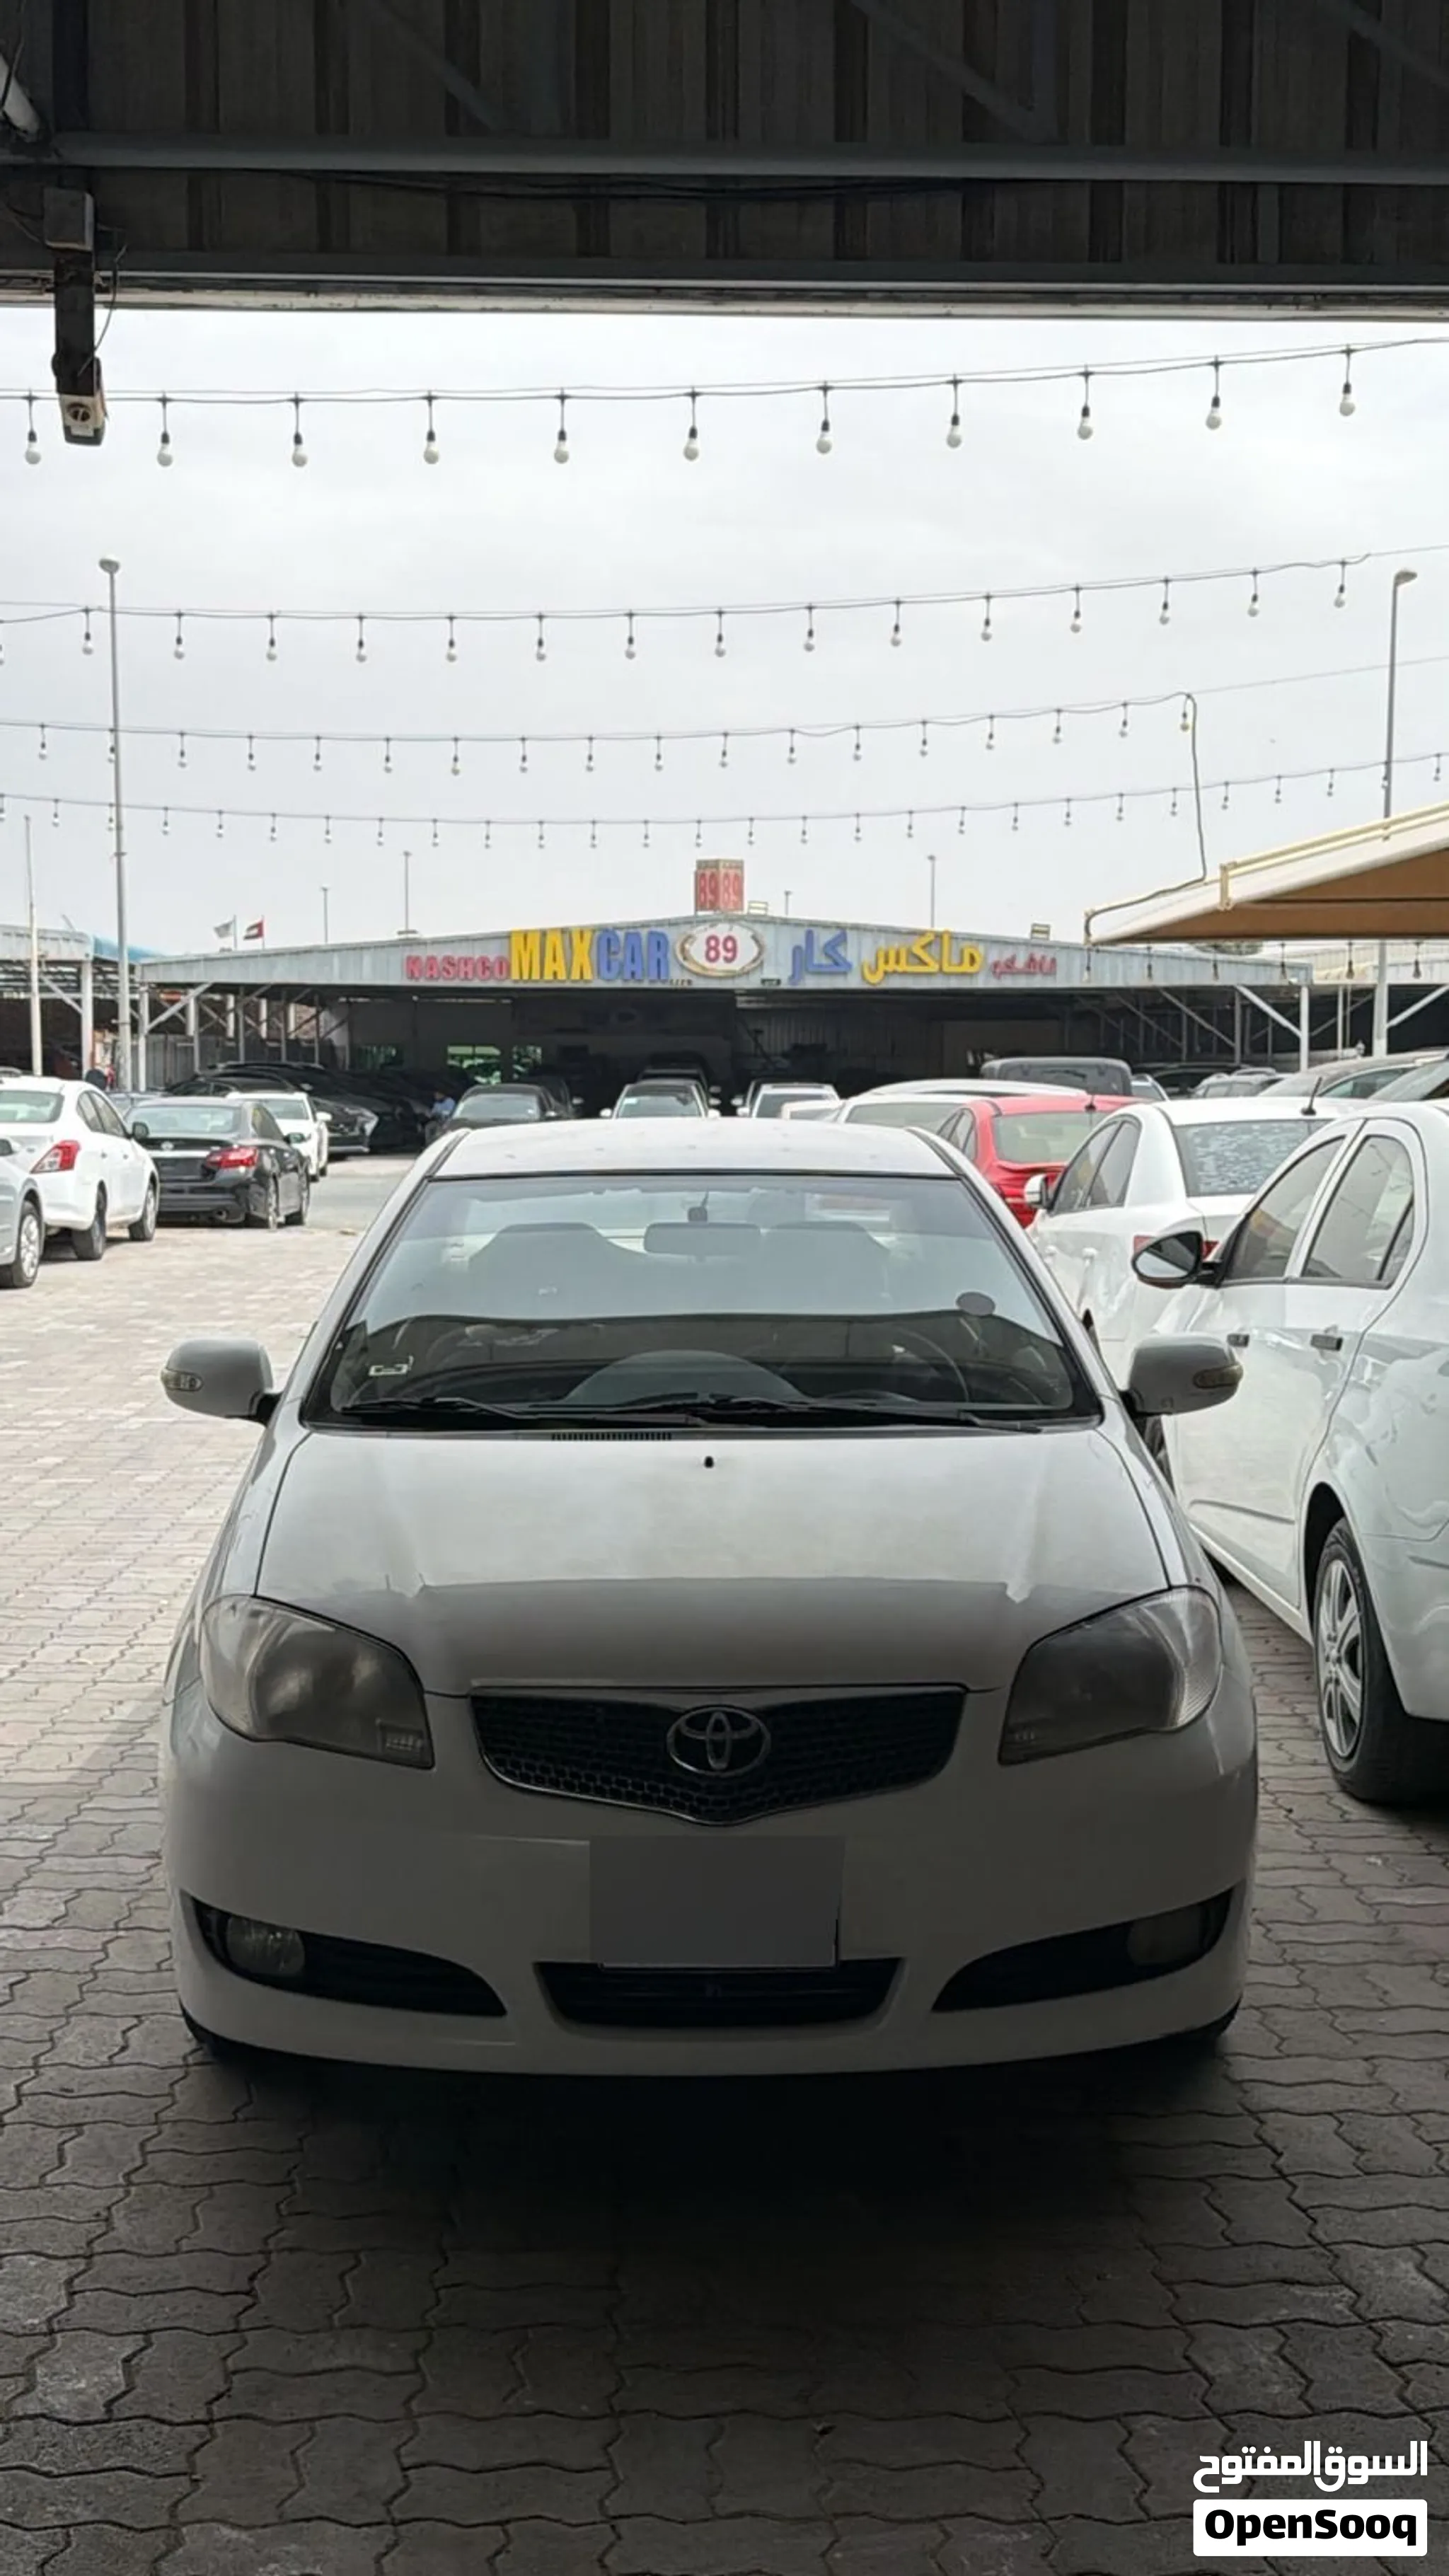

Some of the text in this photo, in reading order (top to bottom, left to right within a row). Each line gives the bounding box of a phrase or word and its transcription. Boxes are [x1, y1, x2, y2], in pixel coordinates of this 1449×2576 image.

[698, 870, 719, 908] 89
[705, 935, 737, 963] 89
[787, 929, 853, 986] كار
[861, 929, 982, 986] ماكس
